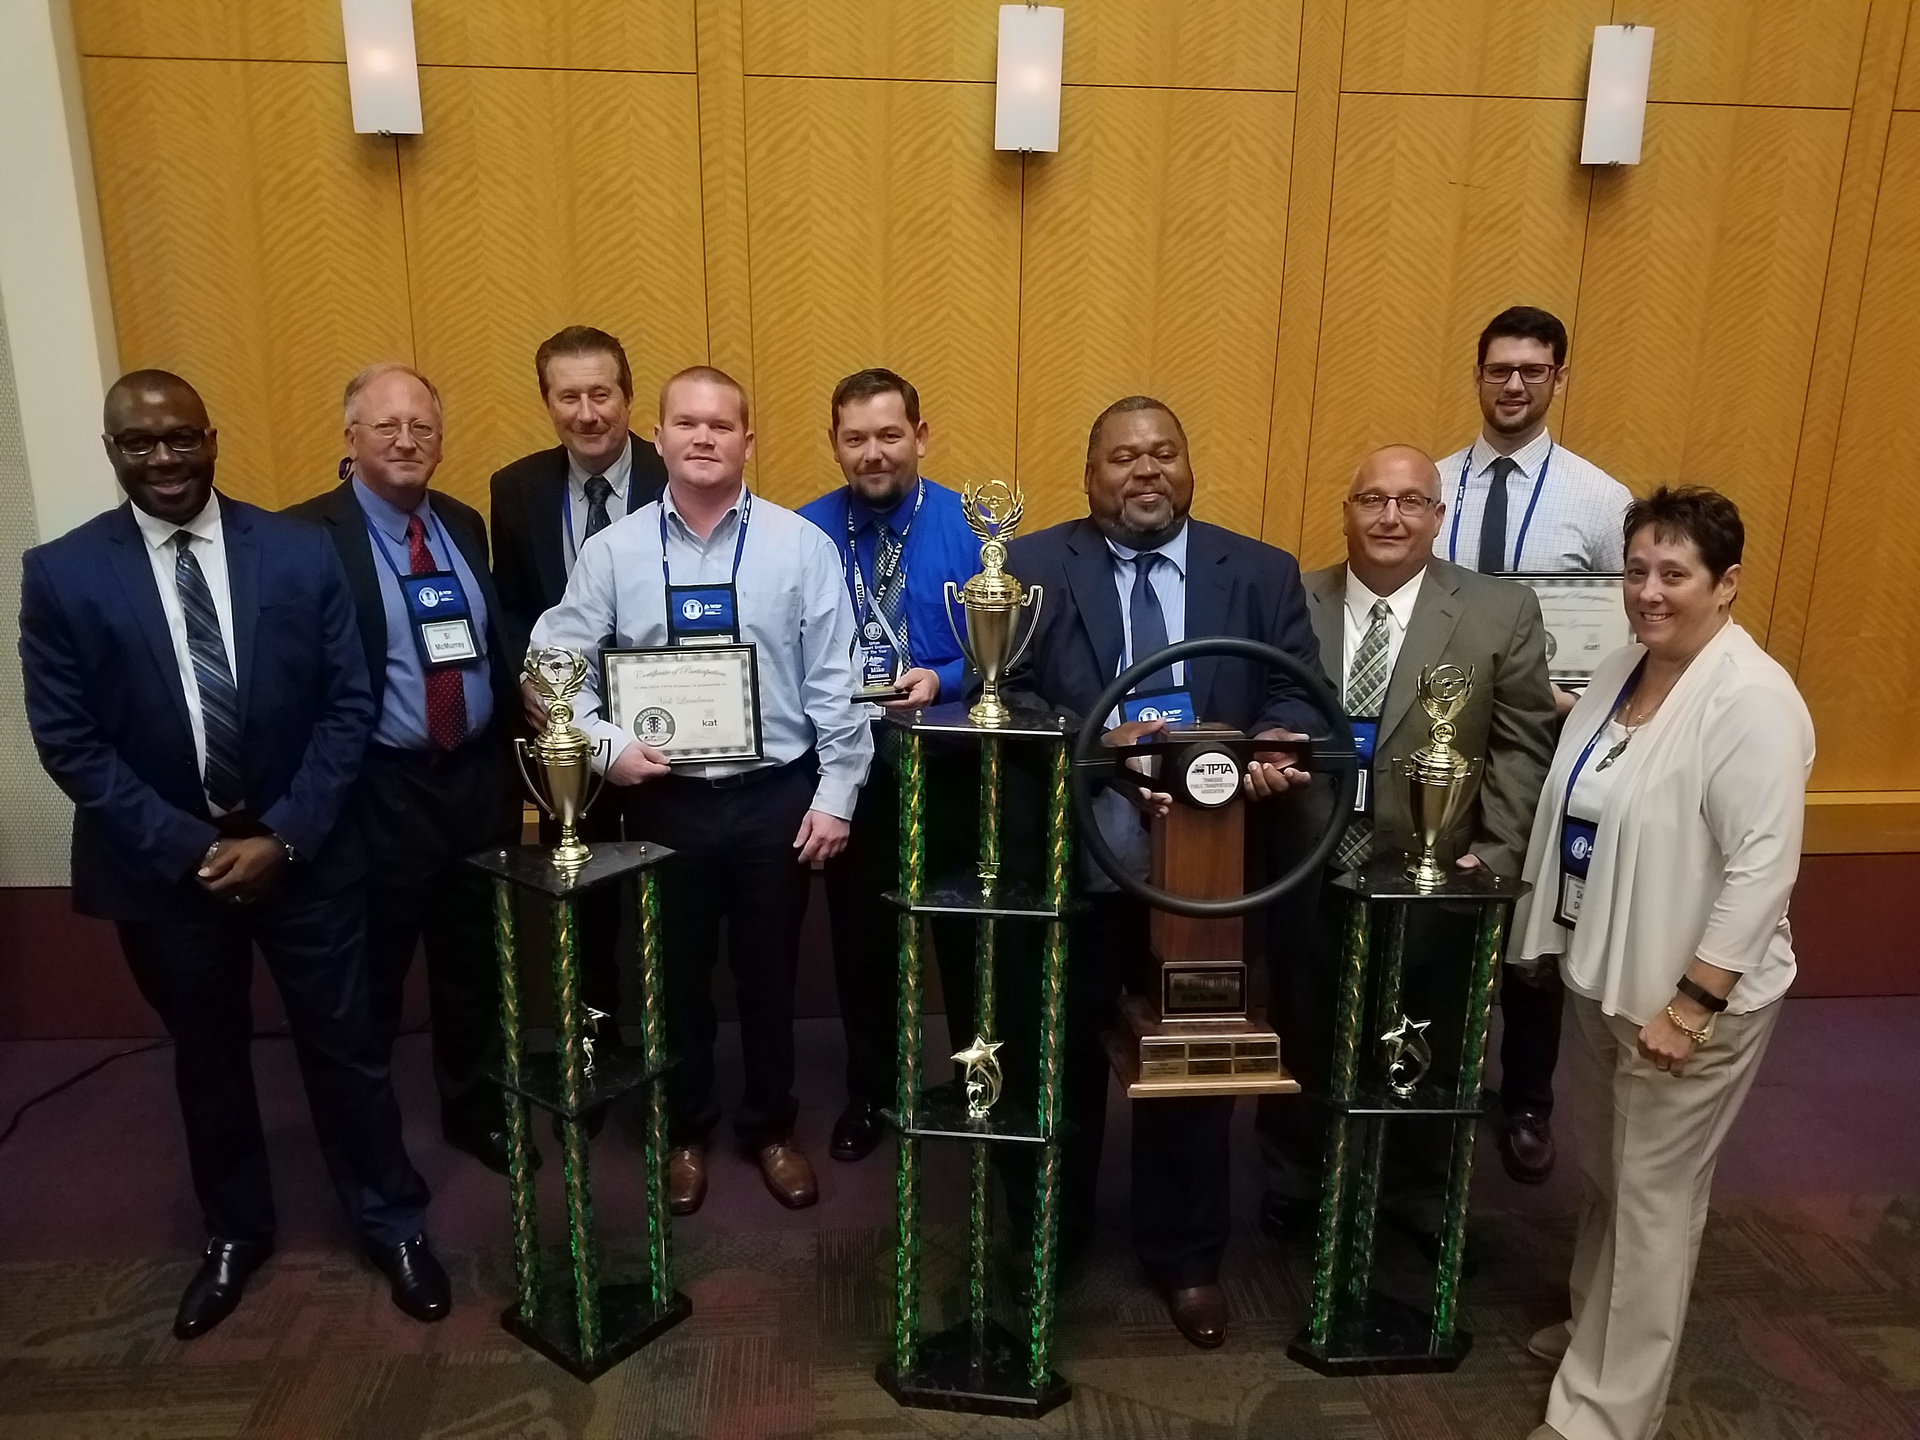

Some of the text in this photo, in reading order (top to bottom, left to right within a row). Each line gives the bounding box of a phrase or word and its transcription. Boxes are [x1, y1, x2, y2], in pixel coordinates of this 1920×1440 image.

[885, 542, 903, 577] OAKLEY
[435, 642, 464, 650] McMurray
[633, 664, 726, 680] Certificate of Participation
[637, 709, 660, 723] MEMPHIS
[702, 719, 718, 727] kat
[1205, 763, 1234, 775] TPTA
